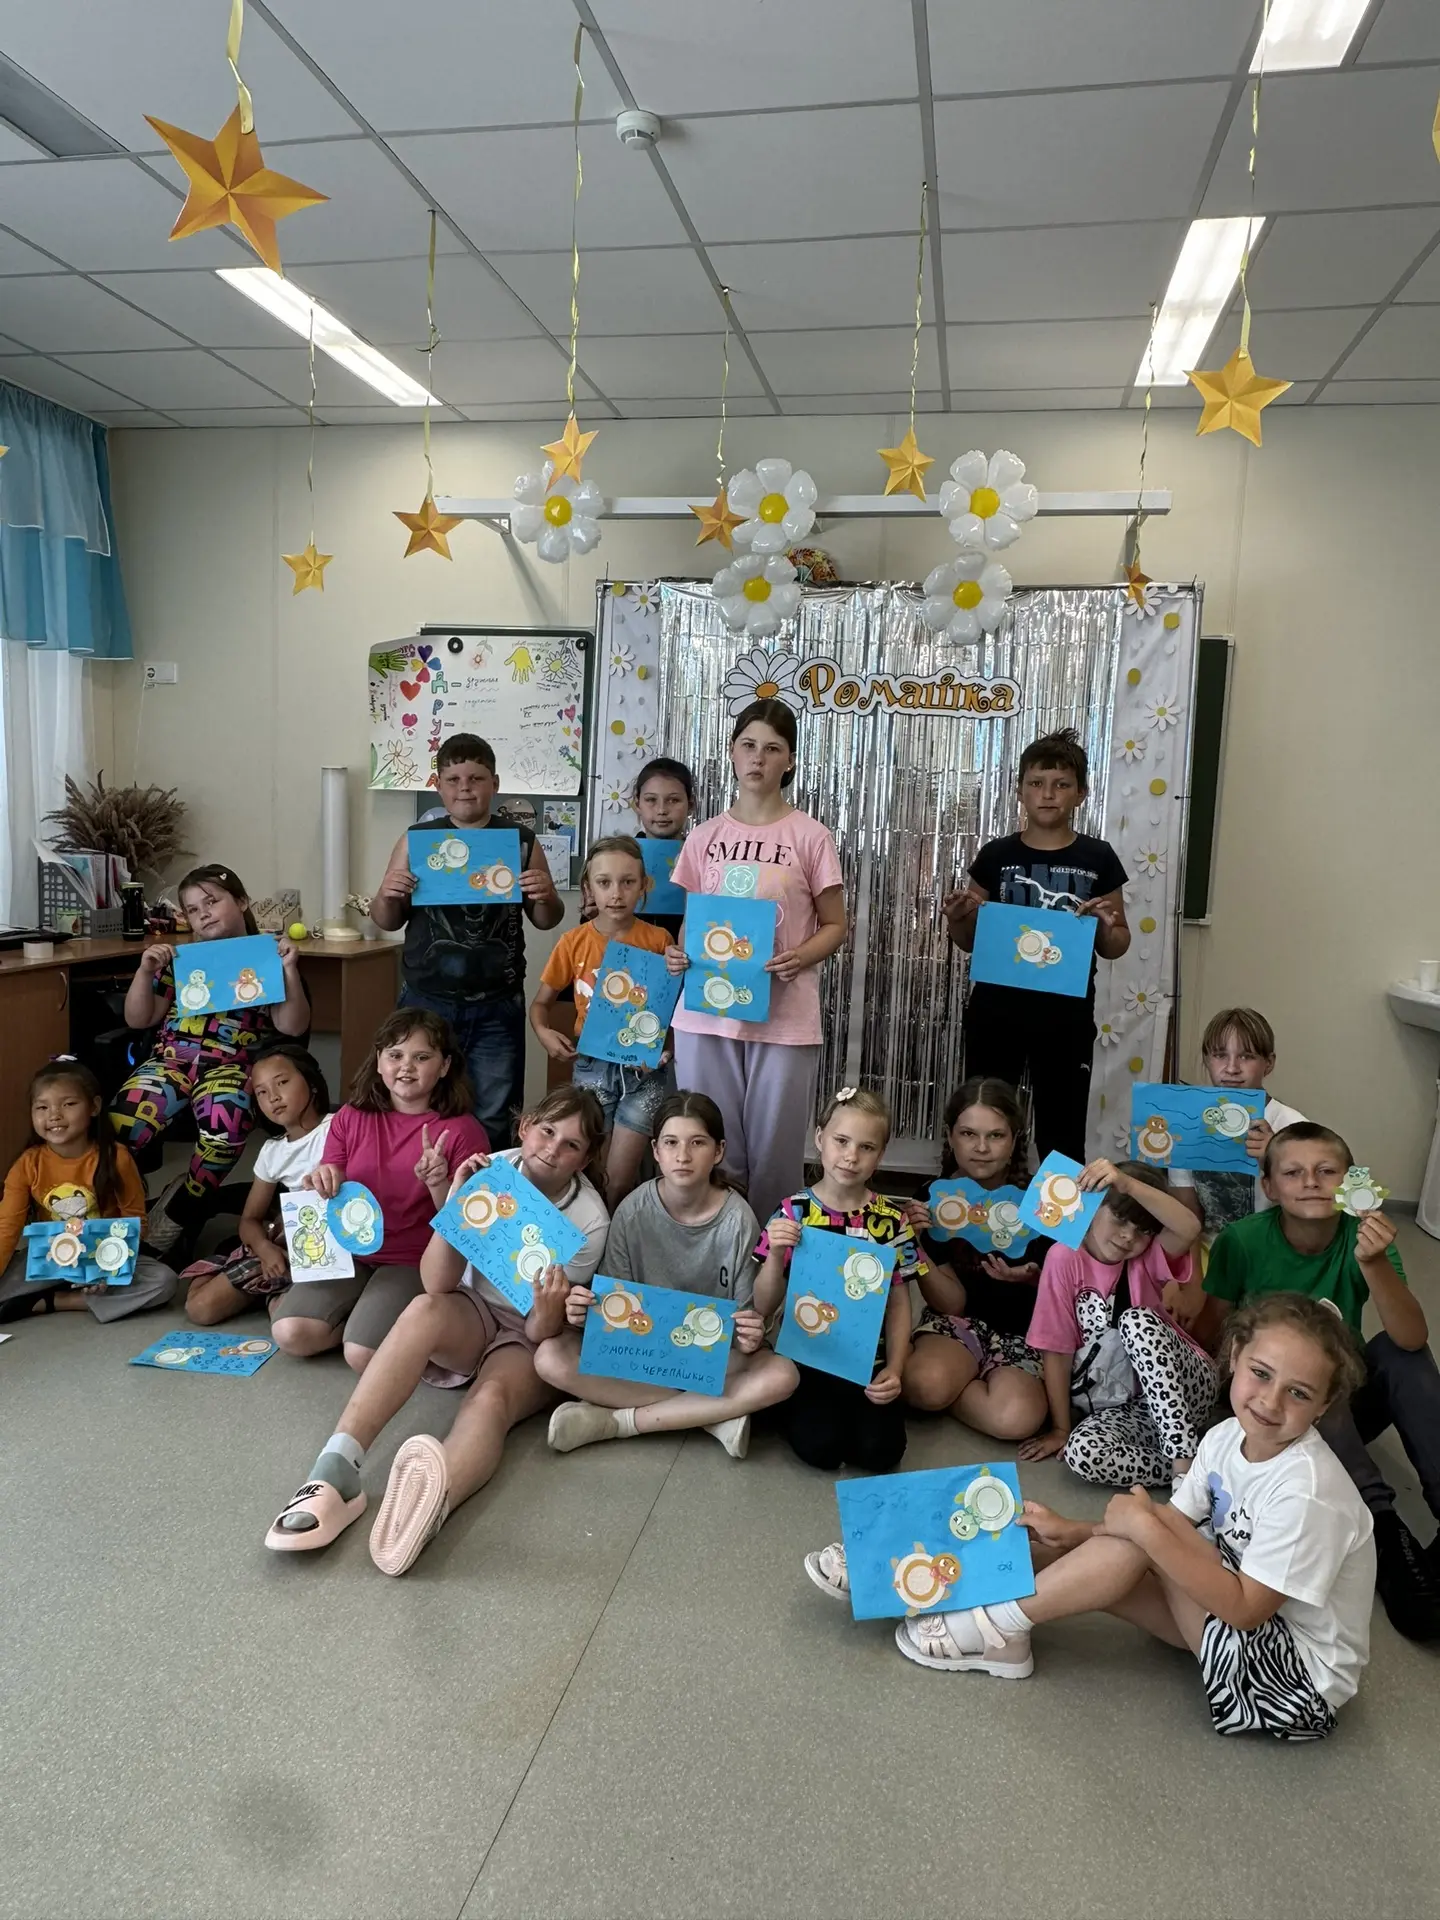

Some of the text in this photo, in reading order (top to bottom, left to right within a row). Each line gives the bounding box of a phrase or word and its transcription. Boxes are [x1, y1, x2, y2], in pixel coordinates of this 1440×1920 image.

[799, 662, 1015, 713] Ромашка
[706, 840, 793, 867] SMILE
[608, 1344, 655, 1358] МОРСКИЕ
[641, 1364, 706, 1382] ЧЕРЕПАШКИ
